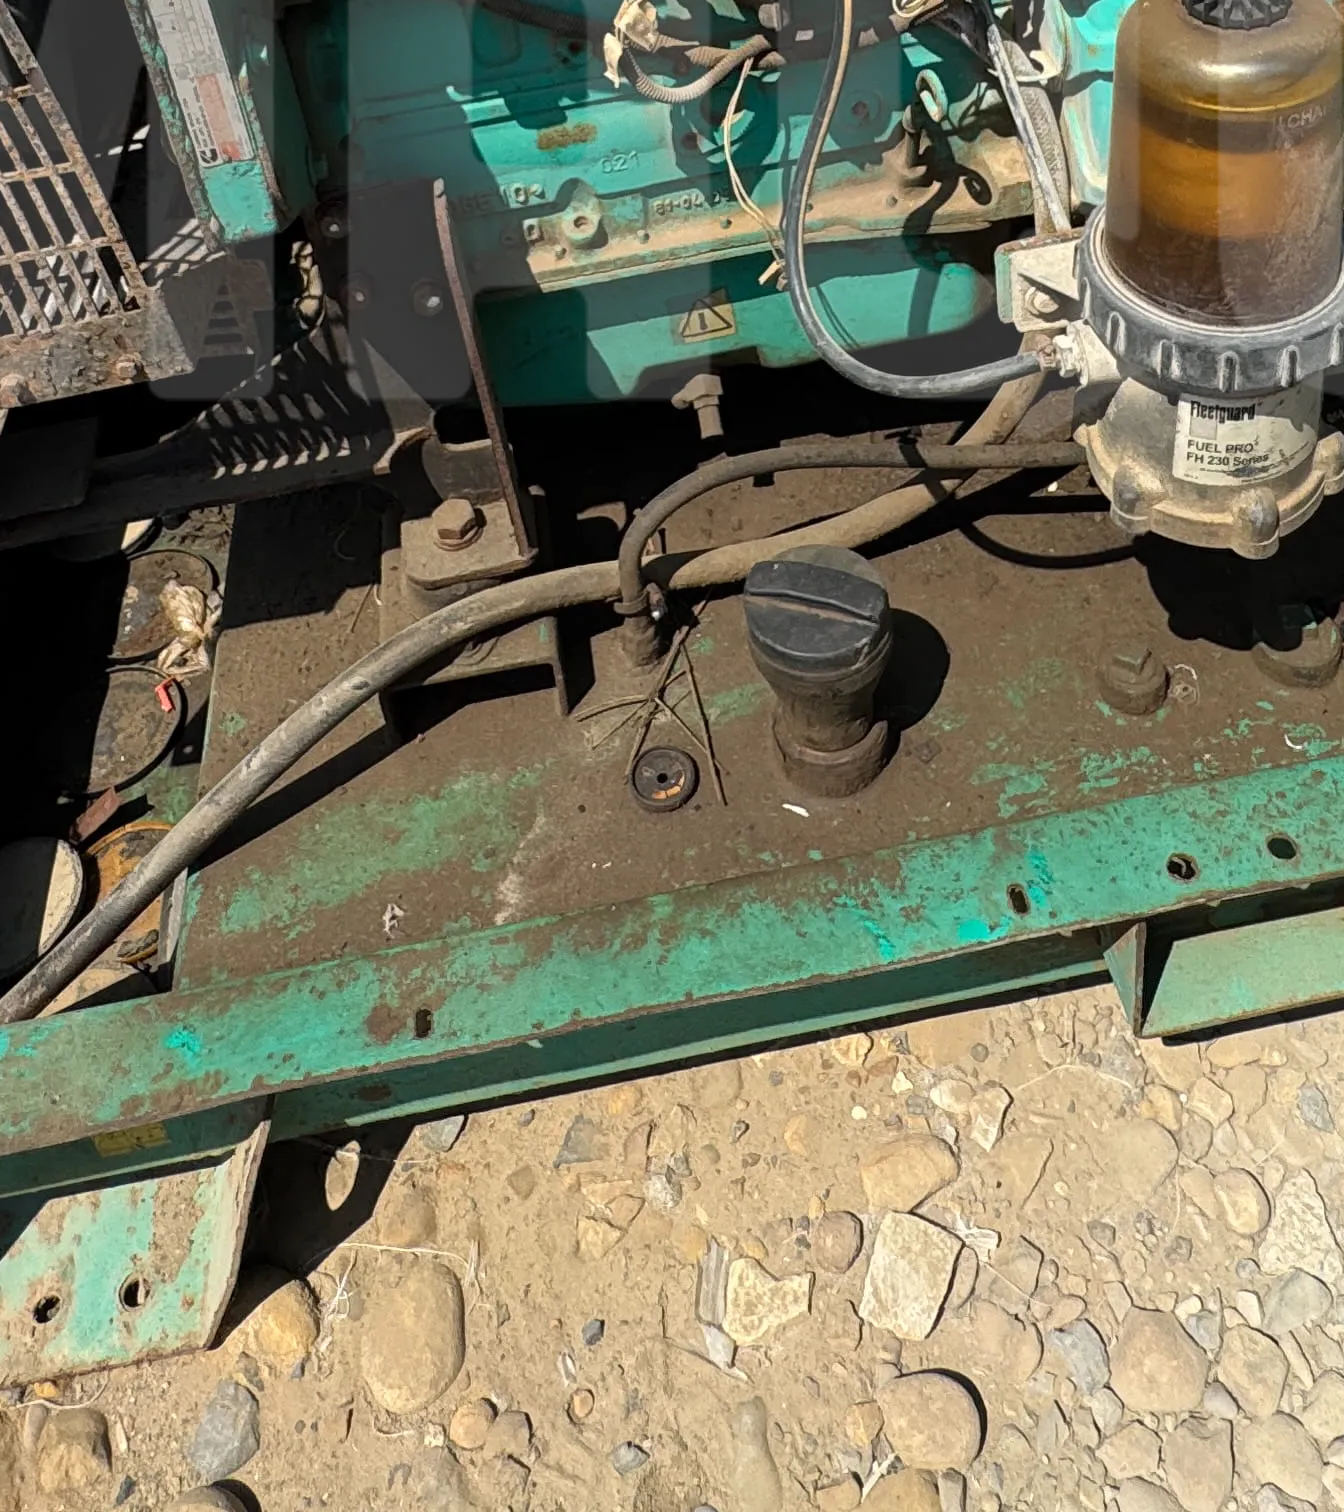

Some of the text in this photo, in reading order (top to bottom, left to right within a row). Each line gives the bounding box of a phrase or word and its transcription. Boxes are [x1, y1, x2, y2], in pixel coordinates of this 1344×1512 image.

[1191, 400, 1256, 424] Fleetguard
[1187, 439, 1254, 454] FUEL PRO
[1186, 452, 1204, 464] FH
[1207, 455, 1230, 466] 230
